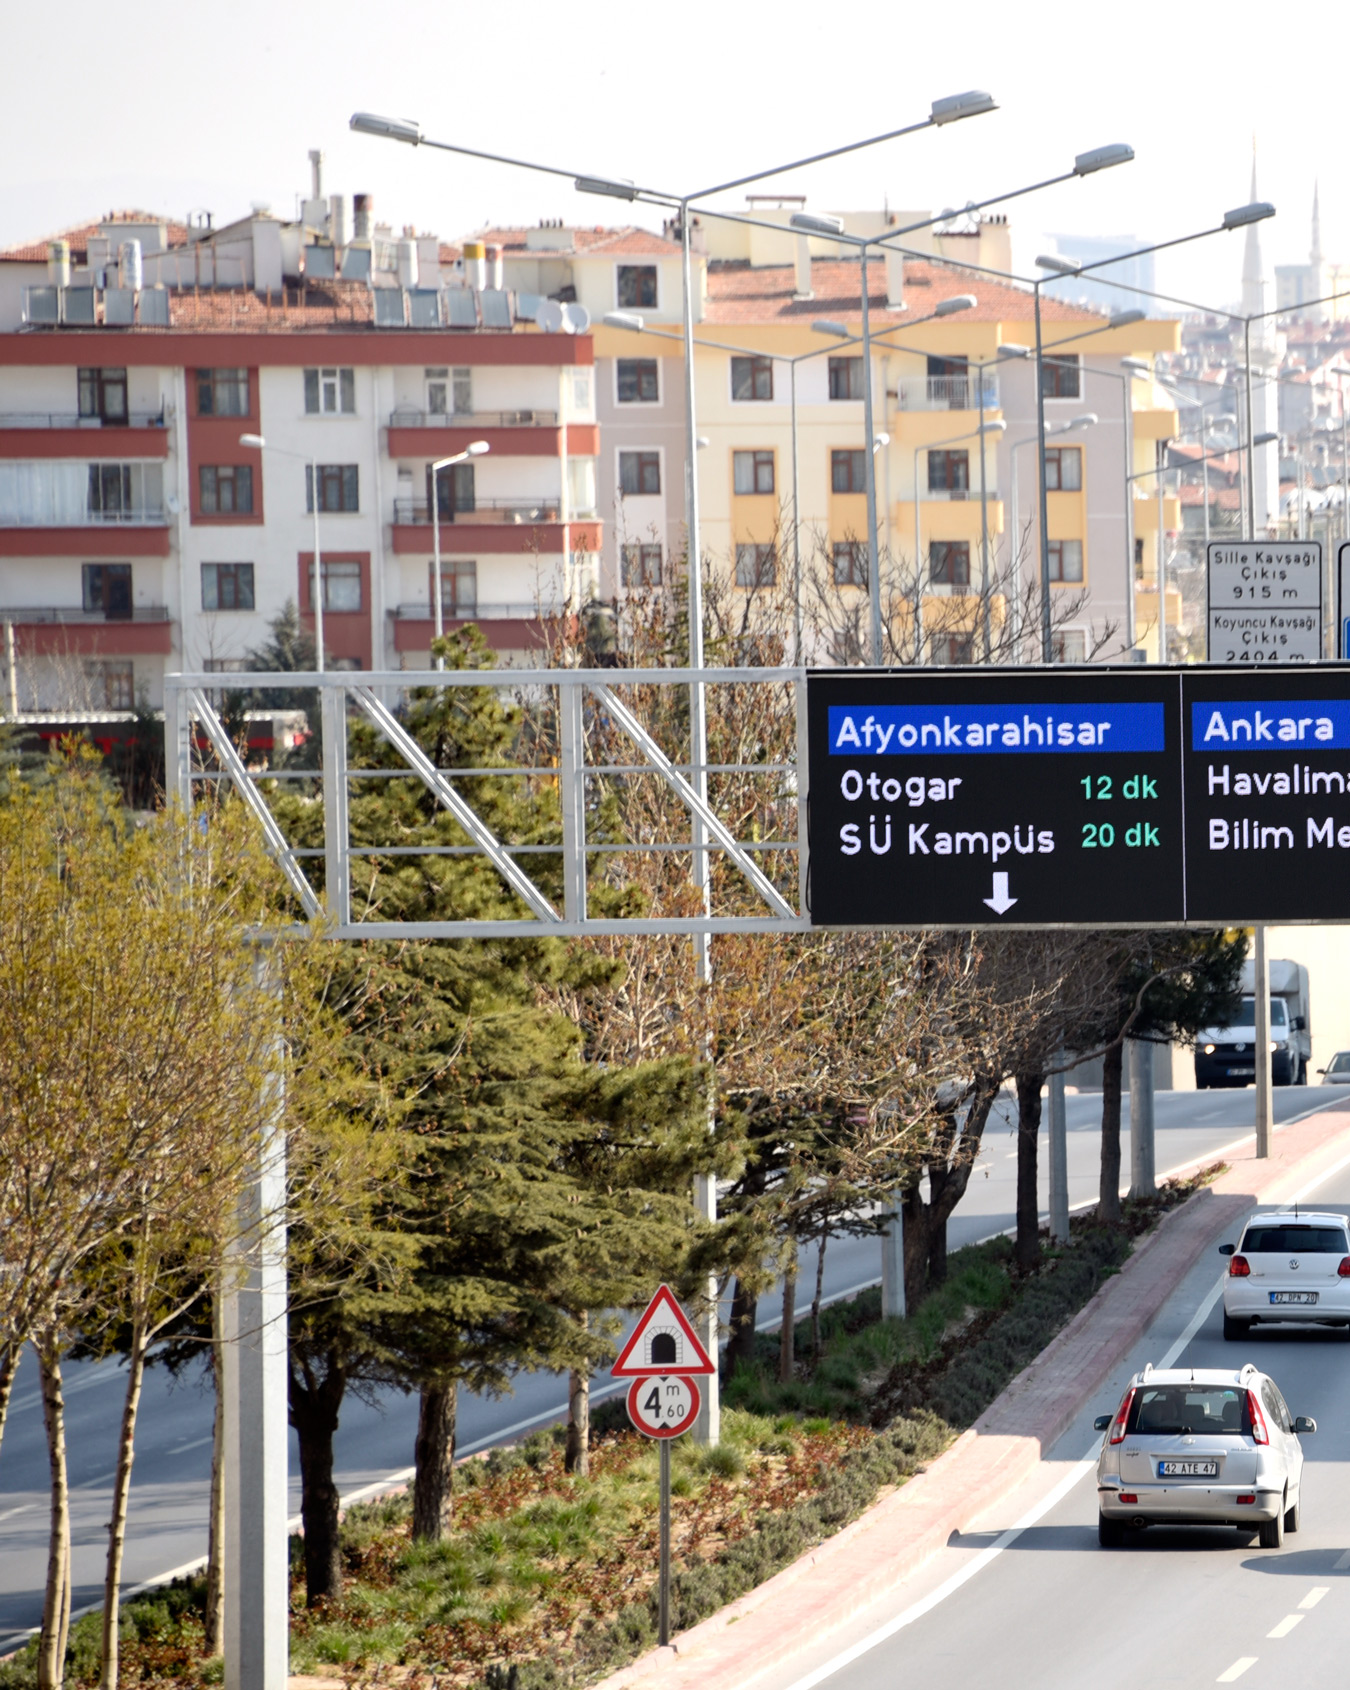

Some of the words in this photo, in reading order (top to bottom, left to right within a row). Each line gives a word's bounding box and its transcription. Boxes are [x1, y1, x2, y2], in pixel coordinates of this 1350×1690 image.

[1214, 551, 1248, 564] Sille
[1255, 550, 1316, 568] Kavşağı
[1242, 567, 1287, 581] Çıkış
[1233, 586, 1272, 599] 915
[1283, 588, 1298, 599] m
[1214, 616, 1267, 632] Koyuncu
[1270, 615, 1317, 631] Kavşağı
[1242, 631, 1288, 646] Çıkış
[836, 714, 1111, 754] Afyonkarahisar
[1205, 711, 1333, 742] Ankara
[840, 770, 962, 807] Otogar
[1080, 776, 1113, 800] 12
[1123, 775, 1158, 800] dk
[840, 816, 892, 855] SÜ
[909, 823, 1055, 863] Kampüs
[1082, 823, 1114, 848] 20
[1125, 822, 1160, 847] dk
[1209, 819, 1293, 852] Bilim
[1275, 1293, 1284, 1302] 42
[1306, 1293, 1315, 1302] 20
[644, 1387, 662, 1419] 4
[667, 1385, 680, 1396] m
[667, 1404, 685, 1418] 60
[1165, 1463, 1177, 1474] 42
[1181, 1463, 1199, 1474] ATE
[1203, 1463, 1215, 1474] 47
